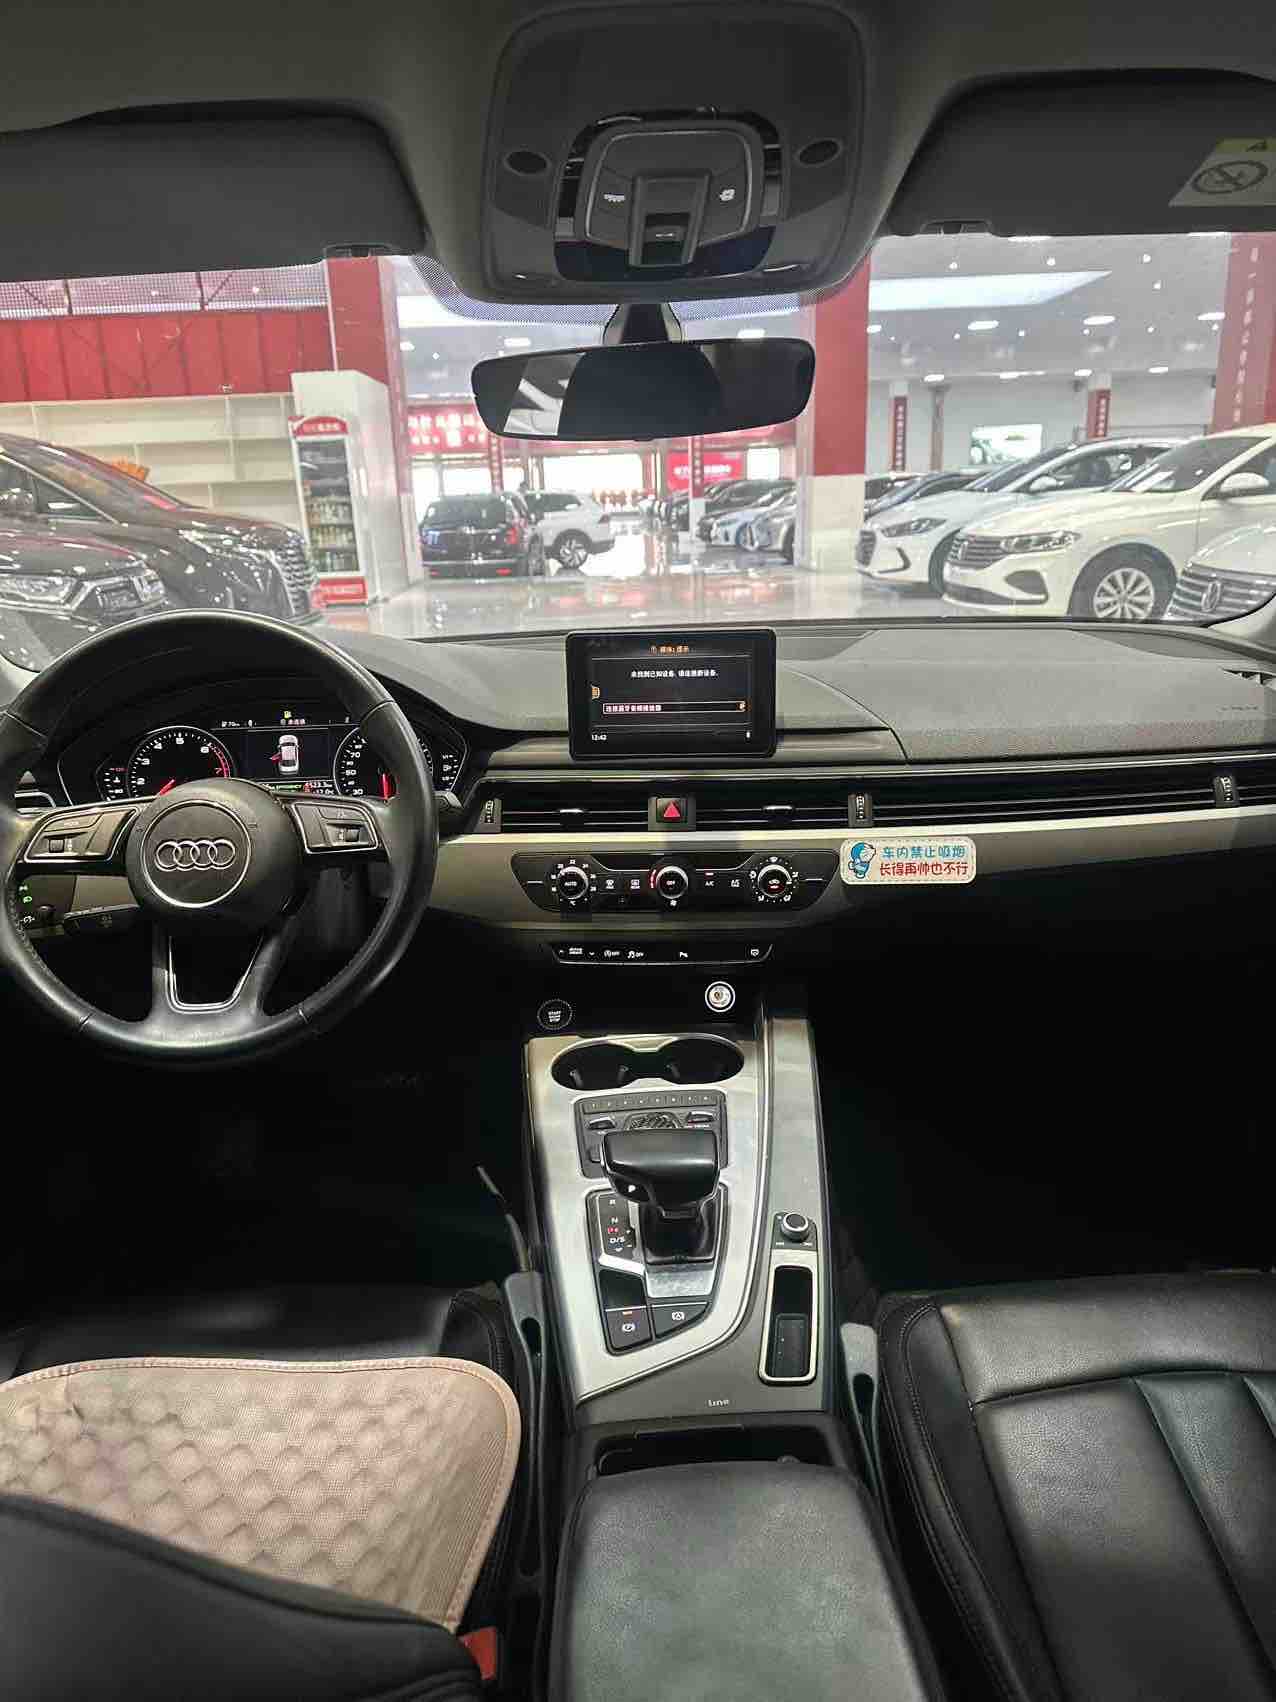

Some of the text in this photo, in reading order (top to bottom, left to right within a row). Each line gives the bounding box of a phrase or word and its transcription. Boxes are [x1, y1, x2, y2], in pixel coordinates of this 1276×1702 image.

[882, 845, 966, 859] 车内禁止吸烟
[880, 860, 969, 876] 长得再帅也不行
